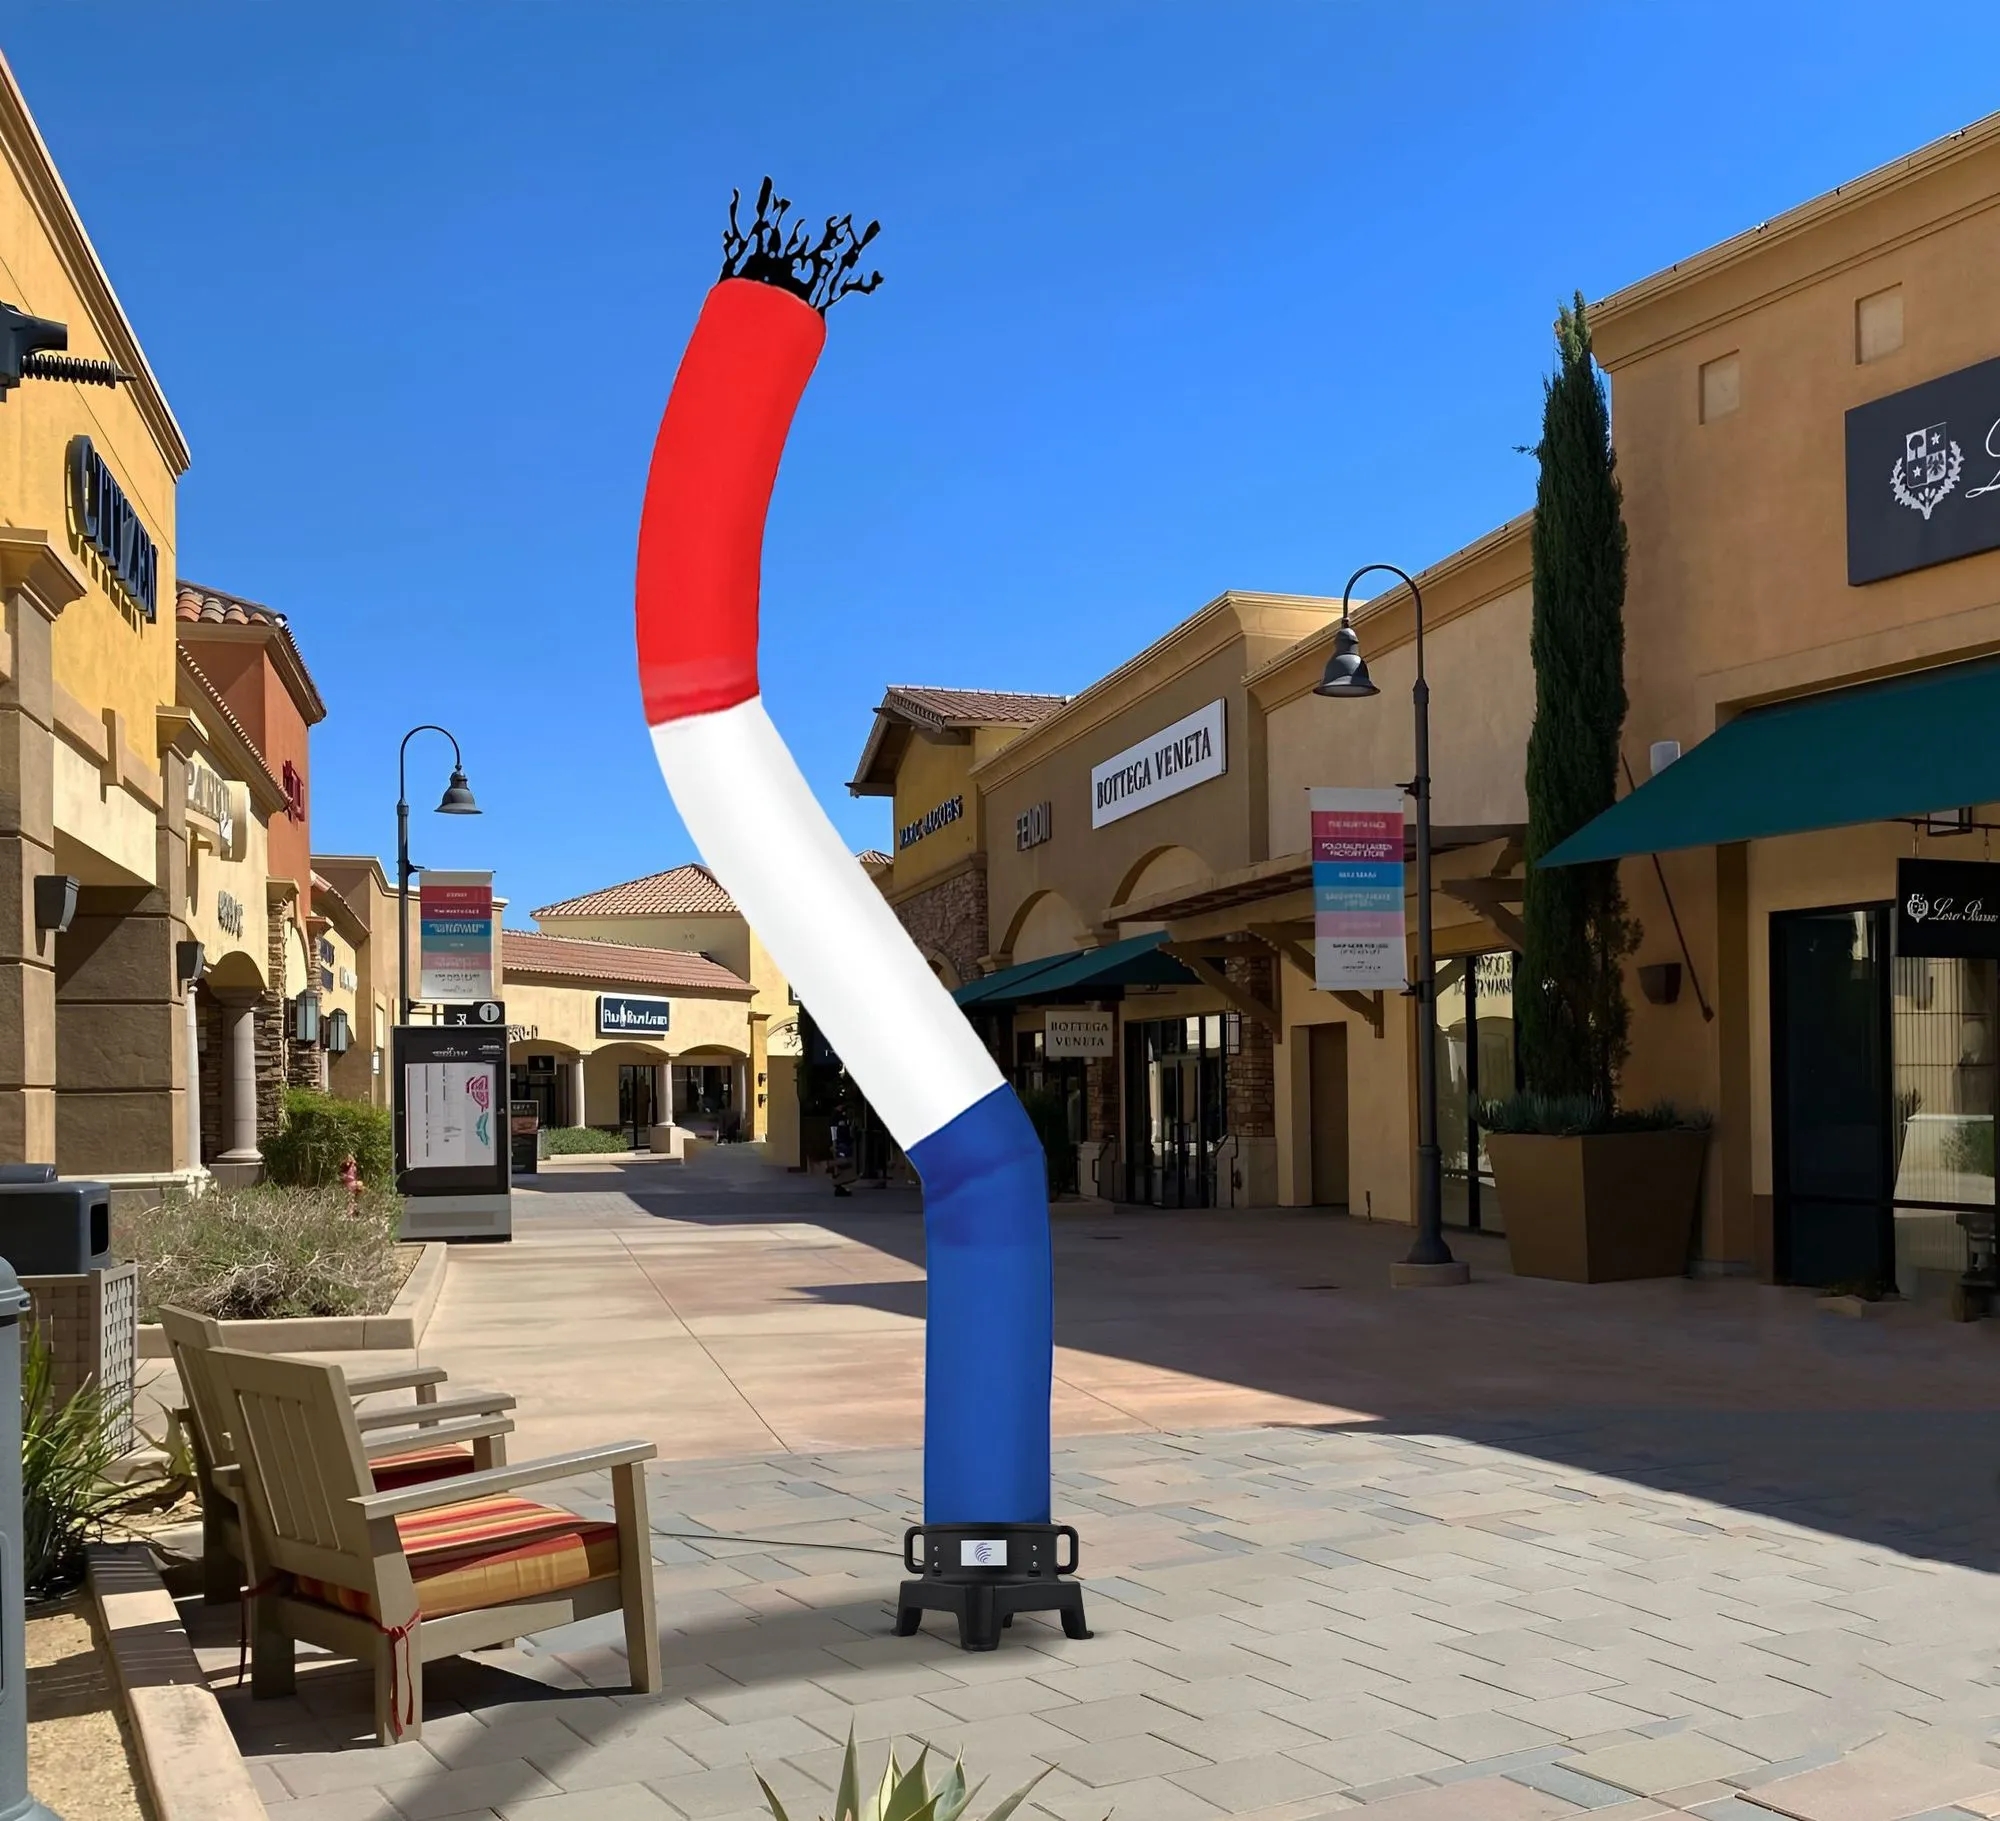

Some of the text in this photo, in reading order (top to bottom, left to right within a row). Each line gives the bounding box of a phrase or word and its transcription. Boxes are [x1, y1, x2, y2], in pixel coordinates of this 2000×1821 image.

[1097, 727, 1211, 809] BOTTEGA VENETA
[1016, 800, 1052, 851] FENDI
[1051, 1022, 1108, 1047] BOTTEGA VENETA
